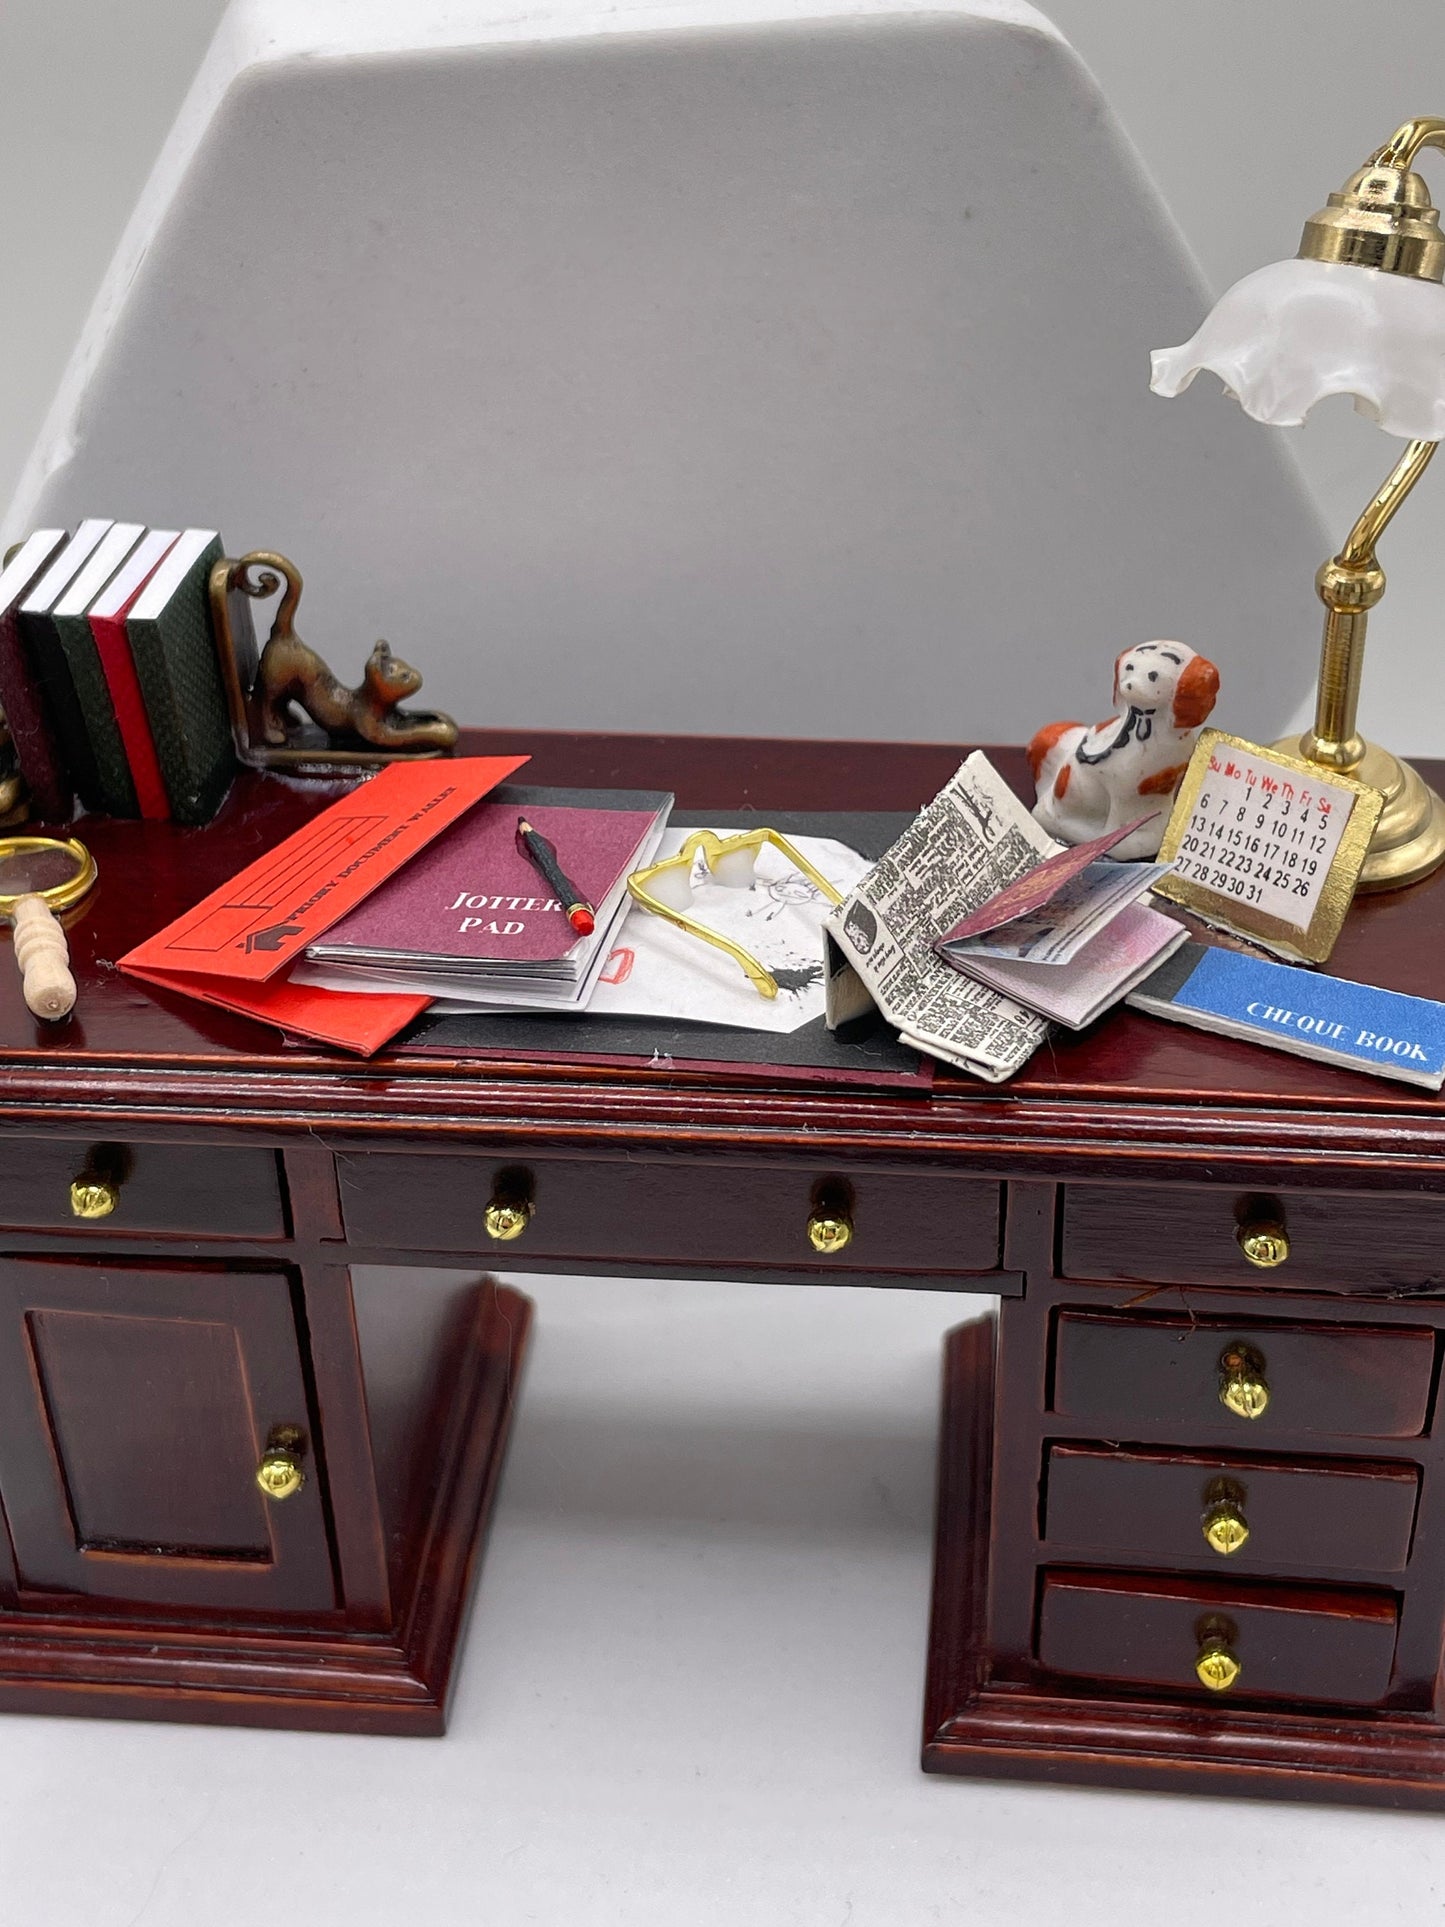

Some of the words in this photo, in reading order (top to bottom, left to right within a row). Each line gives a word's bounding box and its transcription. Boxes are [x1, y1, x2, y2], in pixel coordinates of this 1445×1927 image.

[1208, 756, 1221, 773] Su
[1225, 763, 1241, 779] Mo
[1245, 769, 1257, 787] Tu
[1261, 776, 1278, 794] We
[1281, 783, 1294, 800] Th
[1317, 797, 1332, 813] Sa
[1246, 787, 1252, 800] 1
[1262, 794, 1272, 809] 2
[1282, 801, 1291, 815] 3
[1300, 809, 1309, 823] 4
[1319, 815, 1328, 830] 5
[1191, 815, 1205, 832] 13
[1209, 822, 1224, 839] 14
[1227, 829, 1242, 846] 15
[1245, 835, 1260, 852] 16
[1263, 843, 1280, 860] 17
[1282, 850, 1298, 868] 18
[1302, 858, 1317, 876] 19
[1201, 794, 1211, 808] 6
[1219, 800, 1228, 815] 7
[1237, 807, 1246, 822] 8
[1255, 814, 1265, 829] 9
[1272, 820, 1288, 838] 10
[1291, 828, 1304, 844] 11
[1310, 835, 1326, 854] 12
[286, 880, 339, 921] PRIORY
[337, 824, 409, 879] DOCUMENT
[407, 786, 457, 822] WALLET
[1174, 856, 1190, 873] 27
[1192, 863, 1208, 880] 28
[1210, 870, 1227, 888] 29
[1227, 877, 1244, 896] 30
[1246, 885, 1262, 903] 31
[1182, 834, 1199, 852] 20
[1199, 842, 1215, 859] 21
[1218, 849, 1235, 867] 22
[1235, 855, 1251, 873] 23
[1254, 863, 1271, 881] 24
[1273, 871, 1289, 889] 25
[1292, 878, 1309, 897] 26
[445, 892, 563, 911] JOTTER
[457, 917, 525, 934] PAD
[1247, 1002, 1350, 1041] CHEQUE
[1354, 1030, 1427, 1061] BOOK
